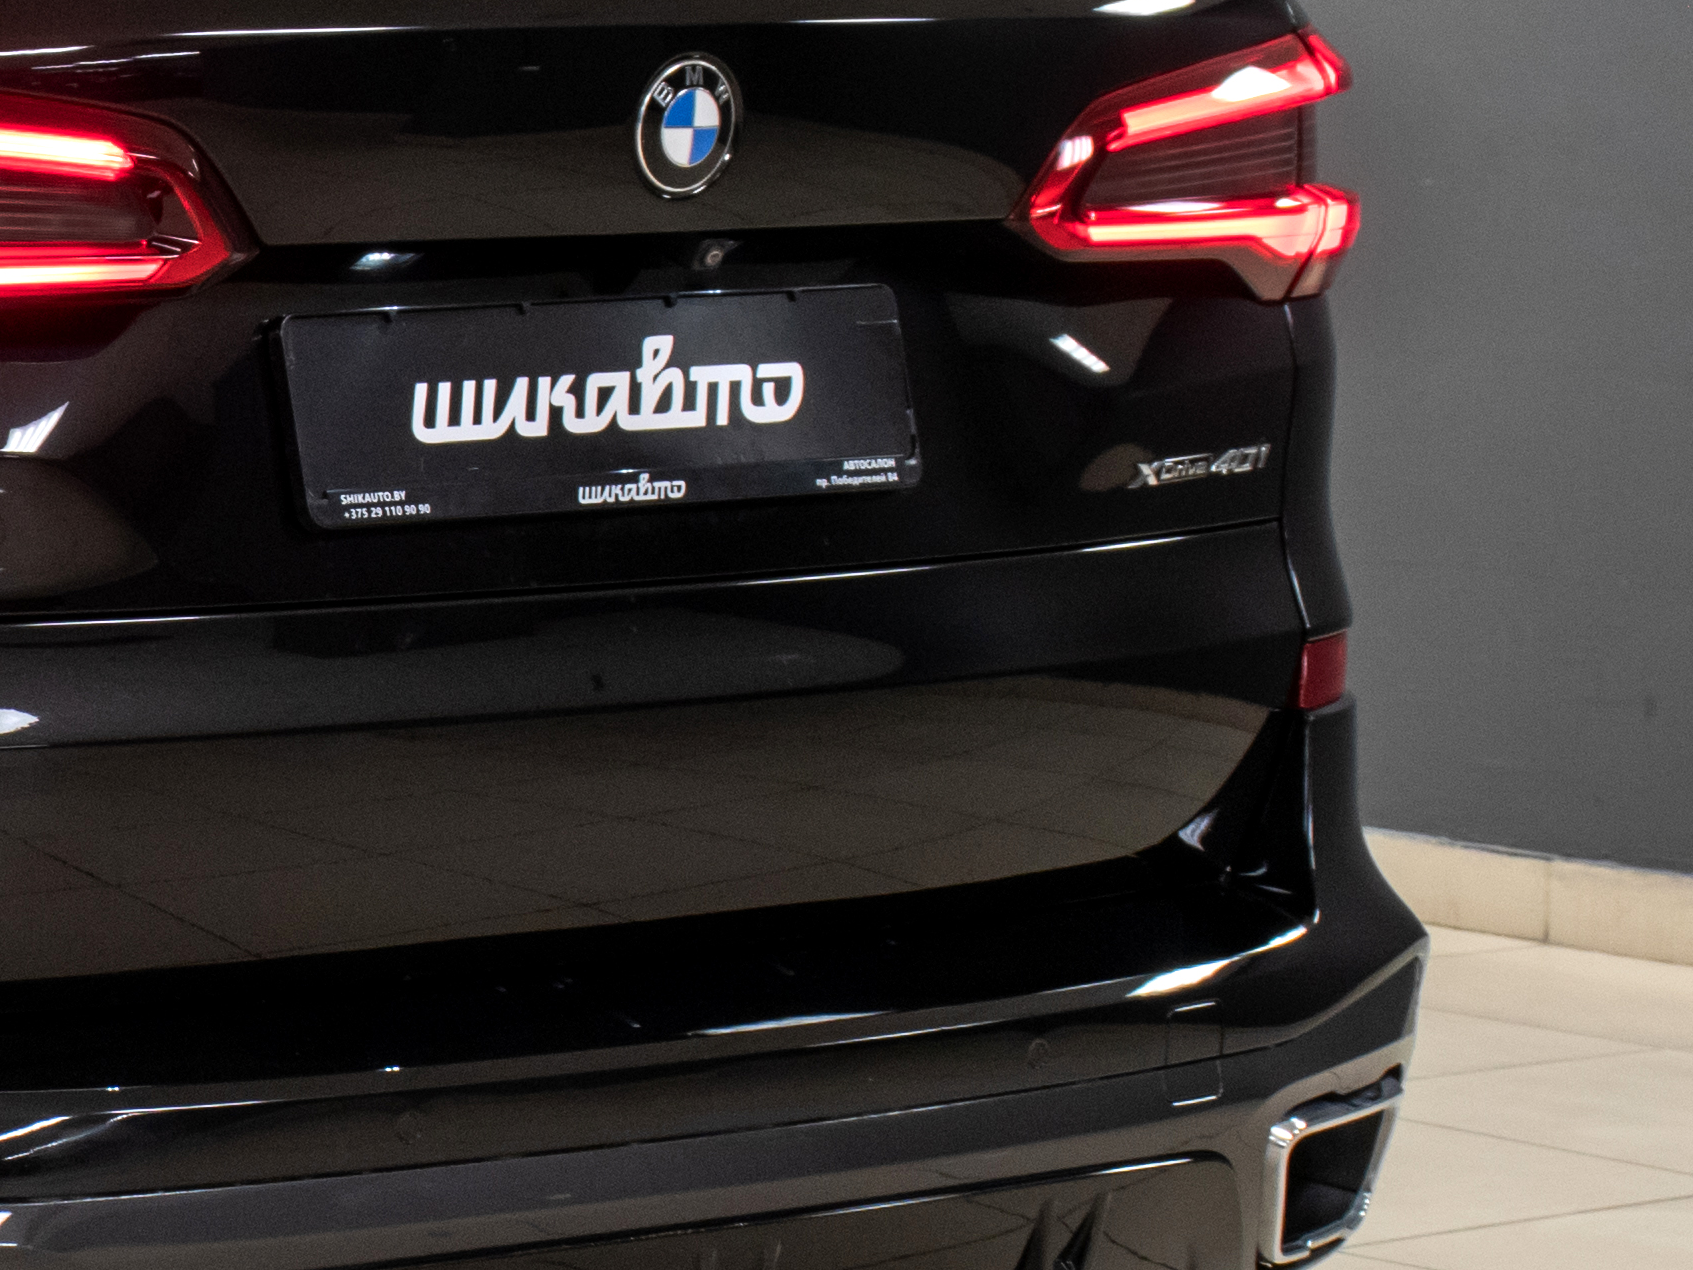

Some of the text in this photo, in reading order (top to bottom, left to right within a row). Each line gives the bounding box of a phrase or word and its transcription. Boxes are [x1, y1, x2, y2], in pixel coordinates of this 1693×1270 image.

[843, 458, 895, 470] АВТОСАЛОН
[830, 472, 887, 486] Победителей
[340, 491, 406, 505] SHIKAUTO.BY
[344, 503, 431, 519] +375 29 110 90 90
